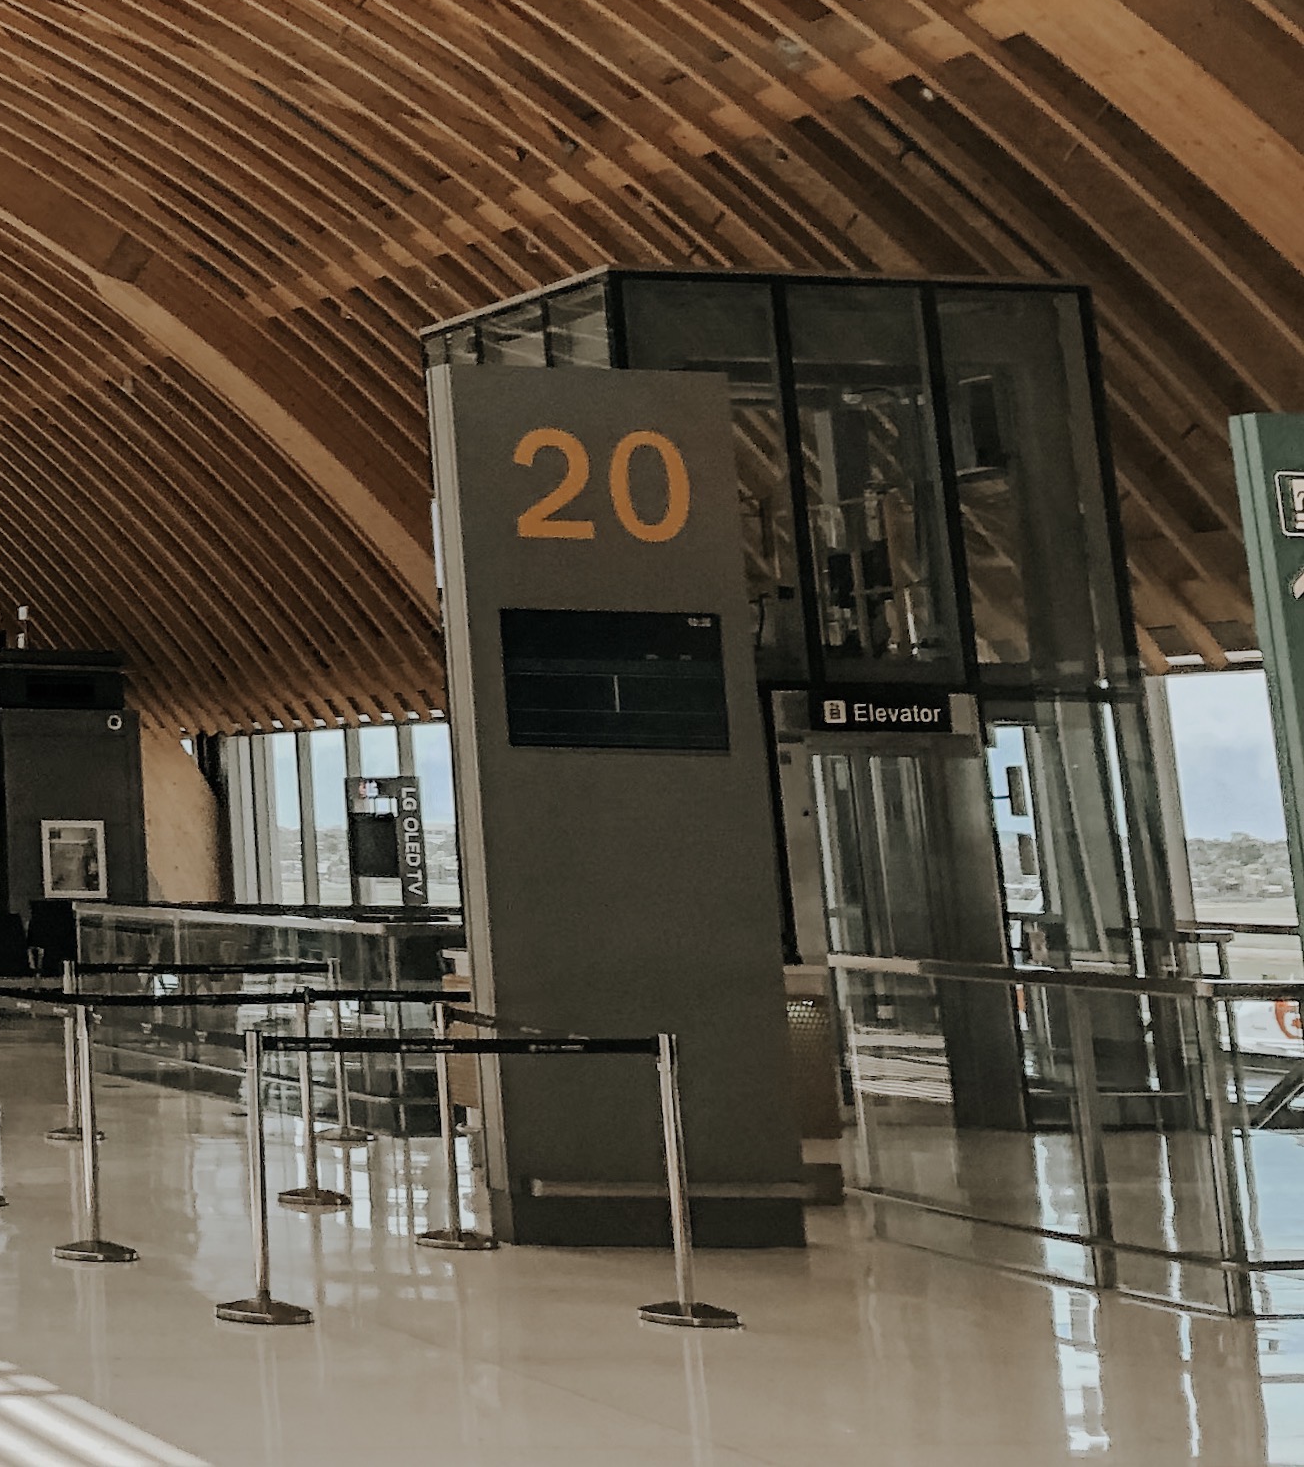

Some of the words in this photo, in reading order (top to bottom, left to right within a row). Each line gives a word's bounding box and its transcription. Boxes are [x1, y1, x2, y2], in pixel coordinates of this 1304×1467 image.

[512, 426, 691, 543] 20
[853, 702, 942, 723] Elevator
[401, 786, 418, 812] LG
[402, 816, 421, 868] OLED
[405, 869, 424, 896] TV
